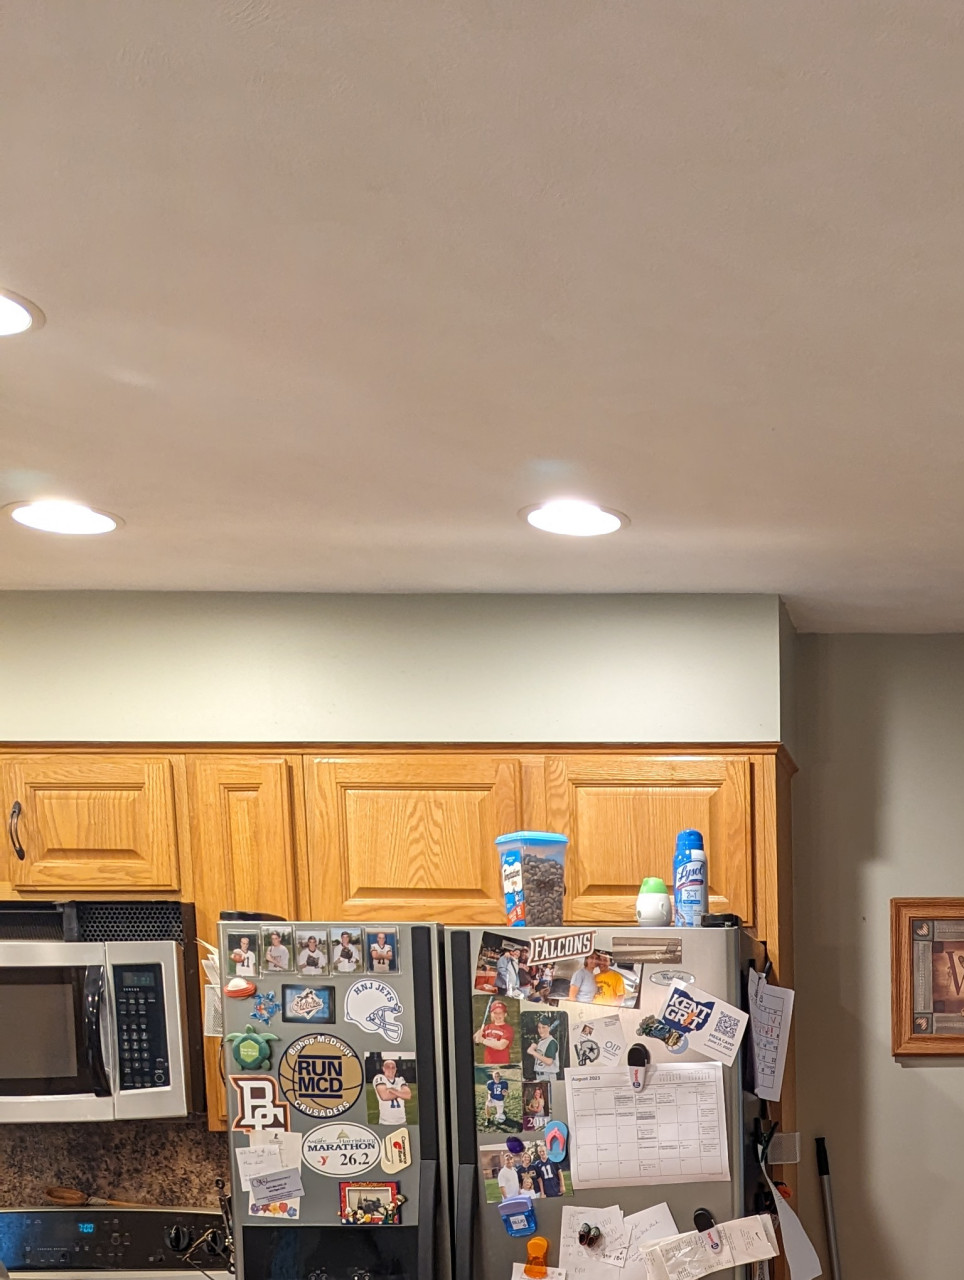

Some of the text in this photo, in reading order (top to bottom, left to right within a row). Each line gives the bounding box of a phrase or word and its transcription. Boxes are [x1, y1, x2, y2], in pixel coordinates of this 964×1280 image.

[677, 863, 705, 882] Lysol
[534, 932, 591, 961] FALCONS
[354, 982, 394, 1003] HNJ JETS
[669, 994, 712, 1019] KENT
[288, 1035, 353, 1058] Bishop McDevitt
[298, 1060, 343, 1077] RUN
[298, 1076, 343, 1093] MCD
[294, 1100, 350, 1117] CRUSADERS
[307, 1142, 376, 1152] MARATHON
[340, 1152, 371, 1166] 26.2
[541, 1164, 554, 1180] 11
